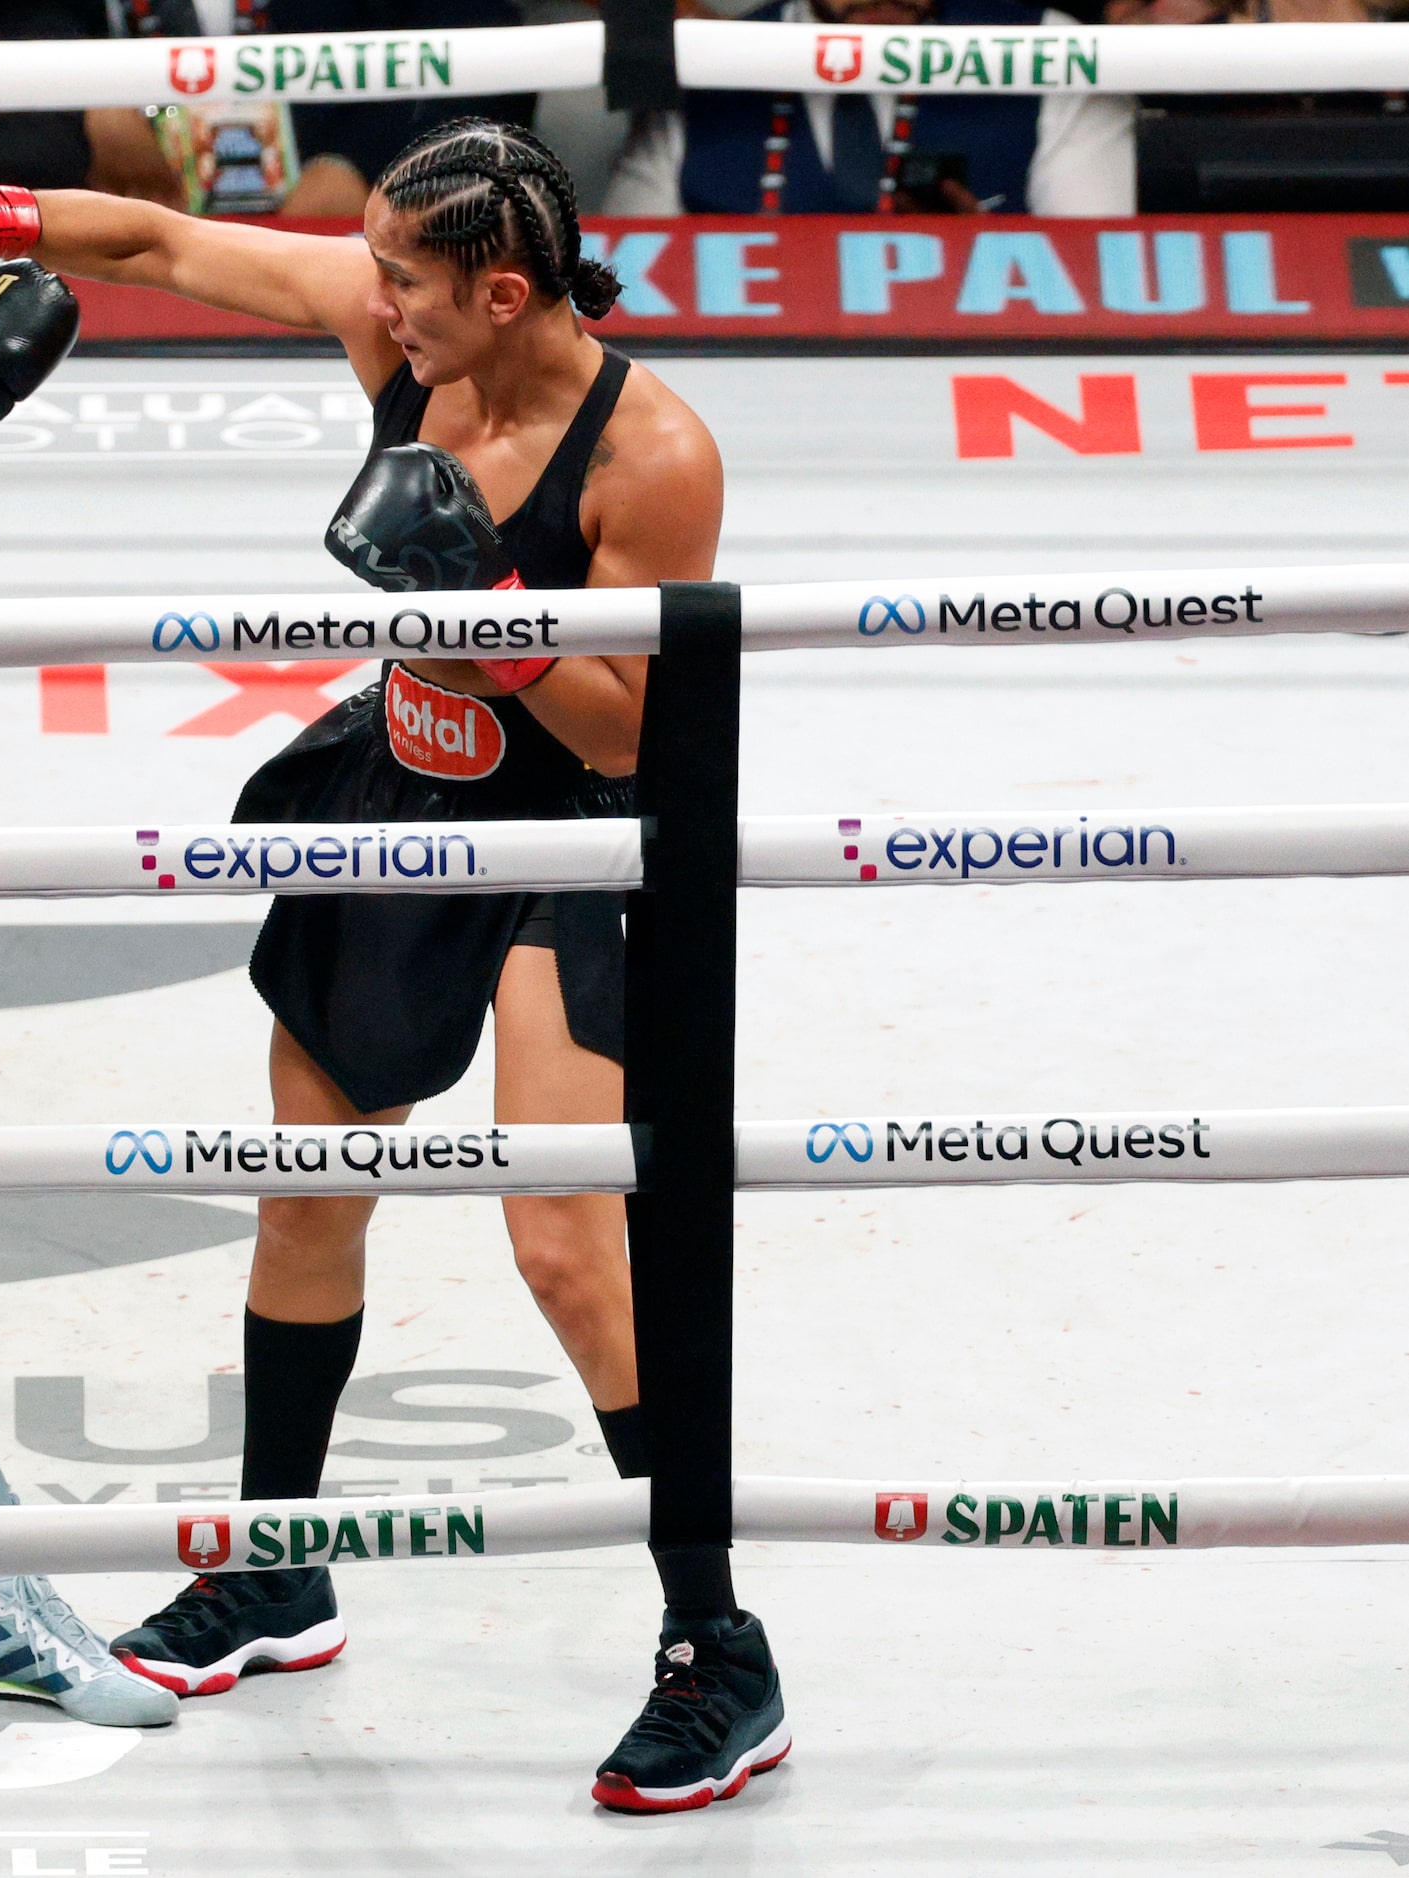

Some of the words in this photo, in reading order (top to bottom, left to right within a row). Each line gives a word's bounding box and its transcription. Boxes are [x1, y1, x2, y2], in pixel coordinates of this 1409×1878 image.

[234, 40, 451, 94] SPATEN
[877, 36, 1098, 86] SPATEN
[837, 231, 1311, 314] PAUL
[331, 514, 419, 592] RIVA
[232, 610, 376, 653] Meta
[388, 608, 560, 654] Quest
[937, 593, 1081, 634] Meta
[1094, 587, 1264, 635] Quest
[183, 827, 476, 888] experian
[885, 815, 1175, 880] experian
[185, 1128, 328, 1174] Meta
[339, 1126, 510, 1179] Quest
[886, 1119, 1028, 1162] Meta
[1040, 1116, 1211, 1168] Quest
[245, 1504, 485, 1569] SPATEN
[942, 1491, 1179, 1546] SPATEN
